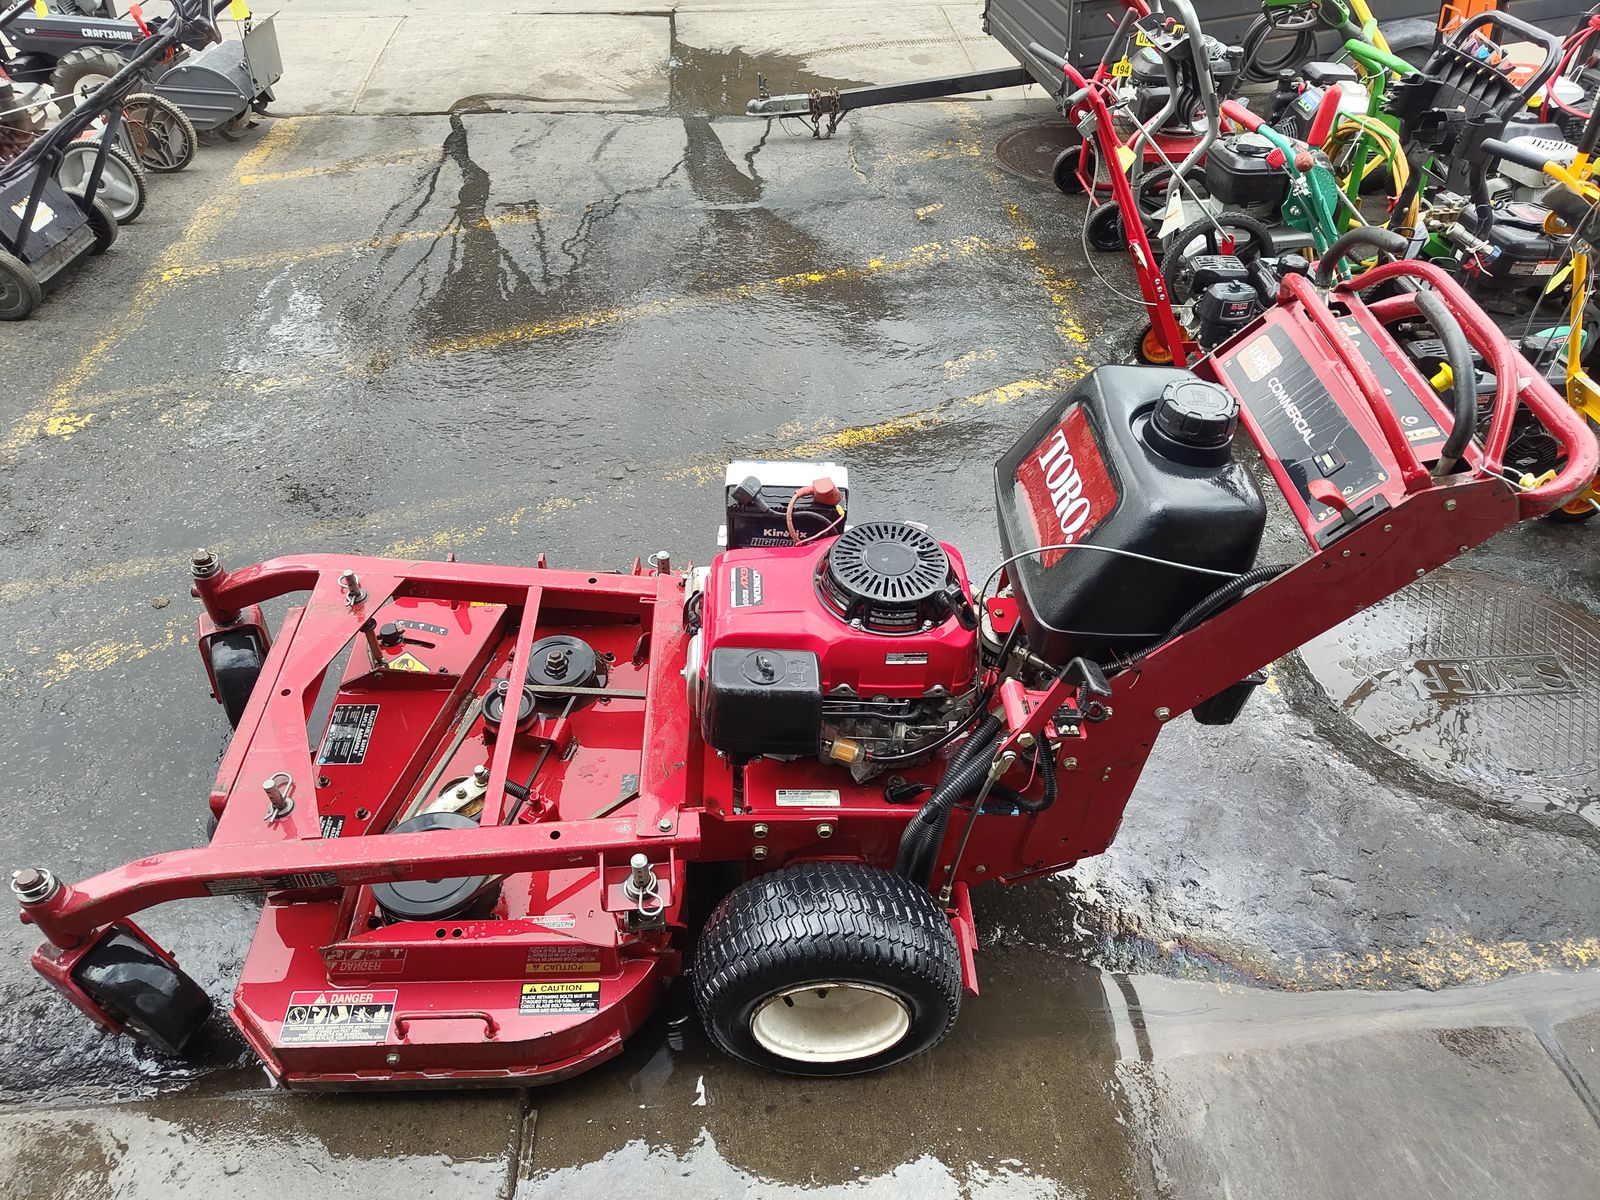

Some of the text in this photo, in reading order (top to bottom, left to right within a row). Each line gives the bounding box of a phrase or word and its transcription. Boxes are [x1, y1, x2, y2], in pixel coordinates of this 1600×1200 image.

[81, 28, 133, 40] CRAFTSMAN
[1116, 65, 1130, 75] 194
[1267, 376, 1316, 446] COMMERCIAL
[1038, 428, 1091, 535] TORO
[751, 537, 779, 547] HIGH
[541, 984, 582, 992] CAUTION
[330, 993, 374, 1004] DANGER
